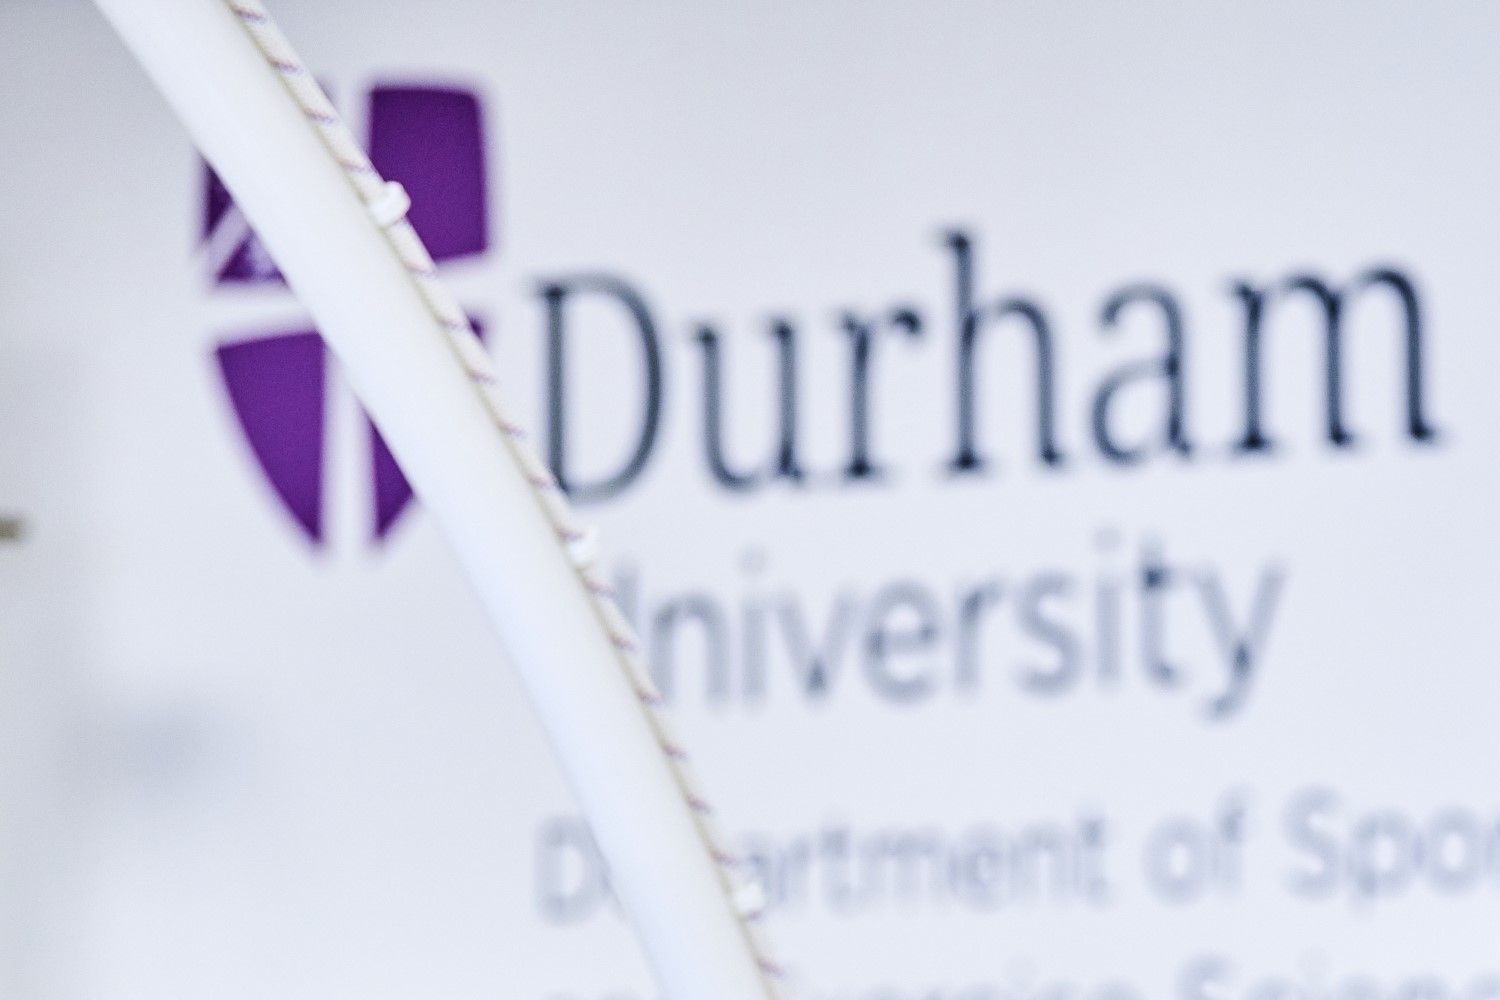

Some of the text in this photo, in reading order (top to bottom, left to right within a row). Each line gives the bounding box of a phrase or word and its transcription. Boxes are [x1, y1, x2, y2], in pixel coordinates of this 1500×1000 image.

[532, 226, 1448, 504] Durham
[535, 806, 1112, 920] Dartment
[1144, 784, 1262, 904] of
